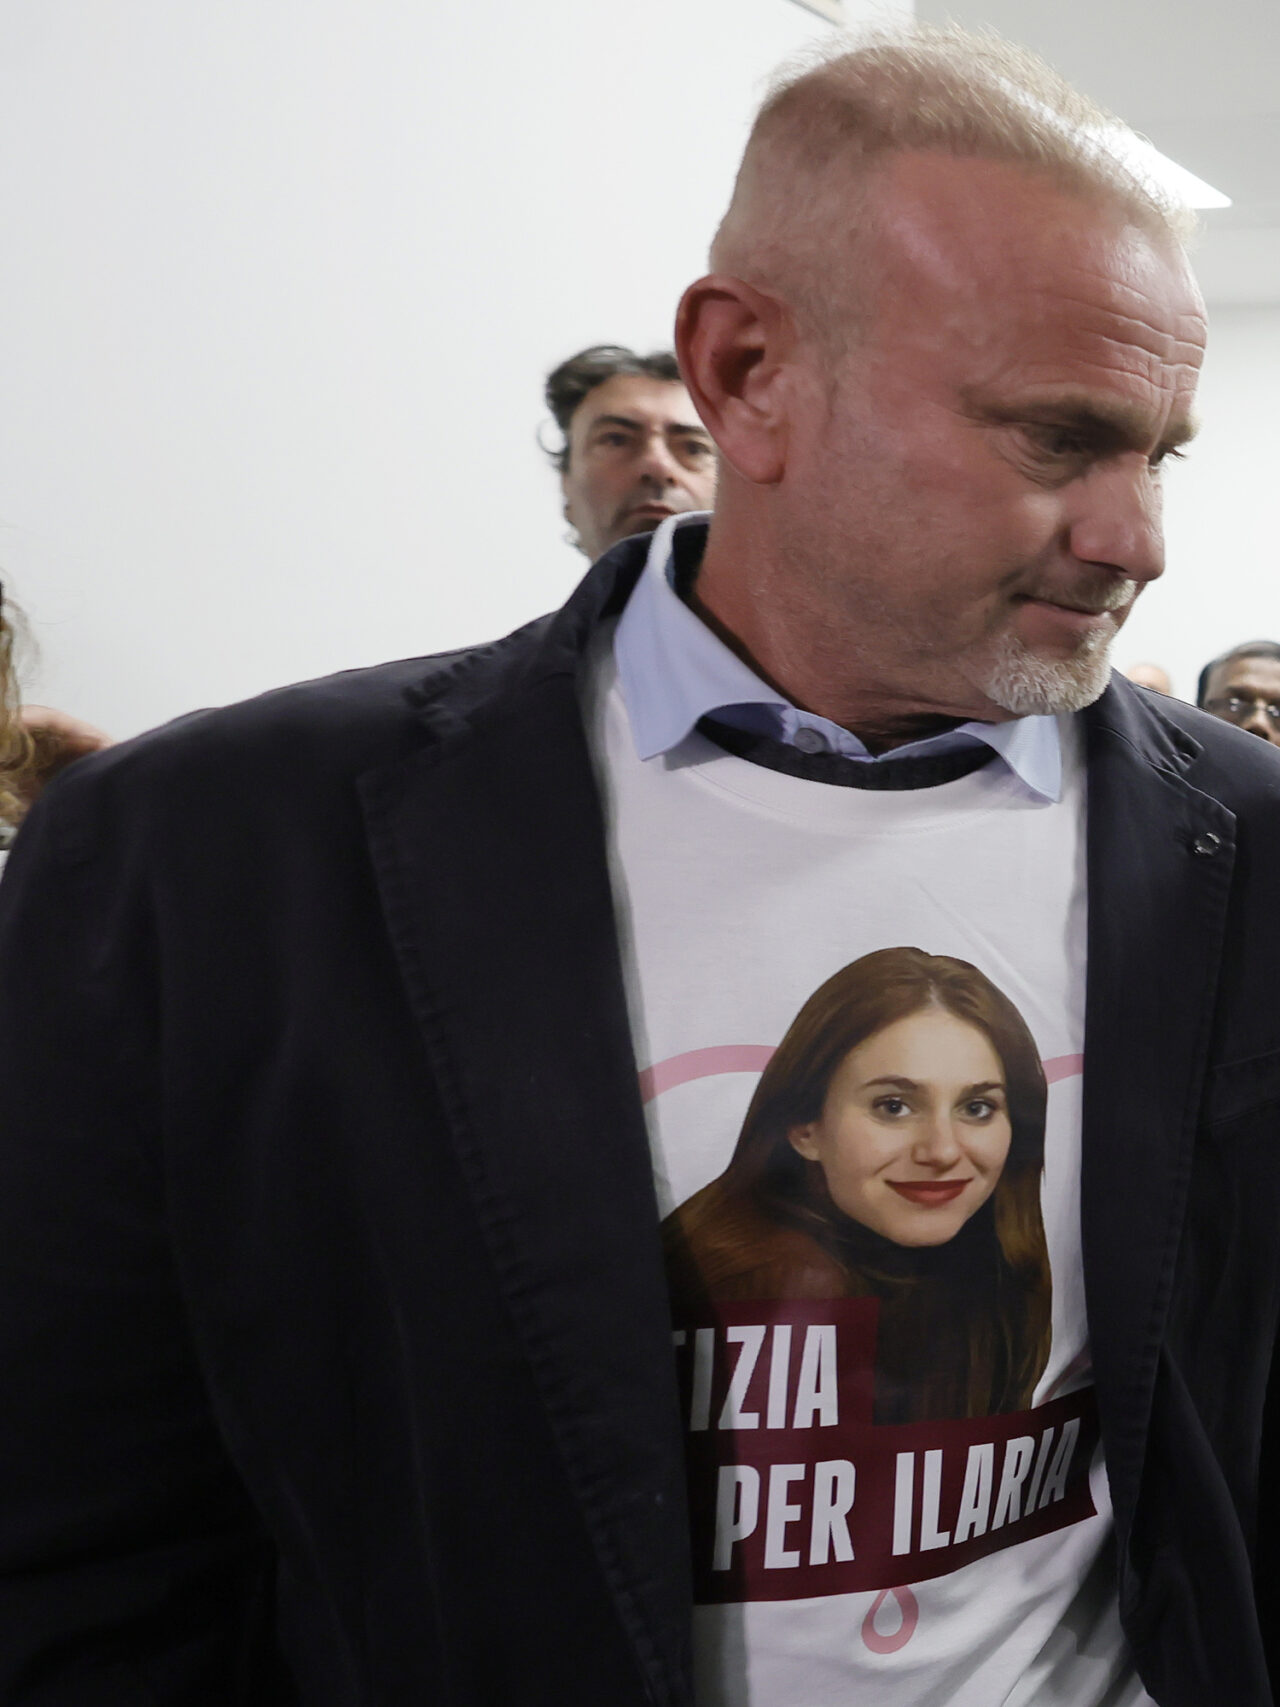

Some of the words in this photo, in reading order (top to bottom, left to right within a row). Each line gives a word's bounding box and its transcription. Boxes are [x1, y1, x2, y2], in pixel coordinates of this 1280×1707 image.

[671, 1324, 839, 1432] IZIA
[712, 1458, 857, 1571] PER
[892, 1416, 1081, 1556] ILARIA
